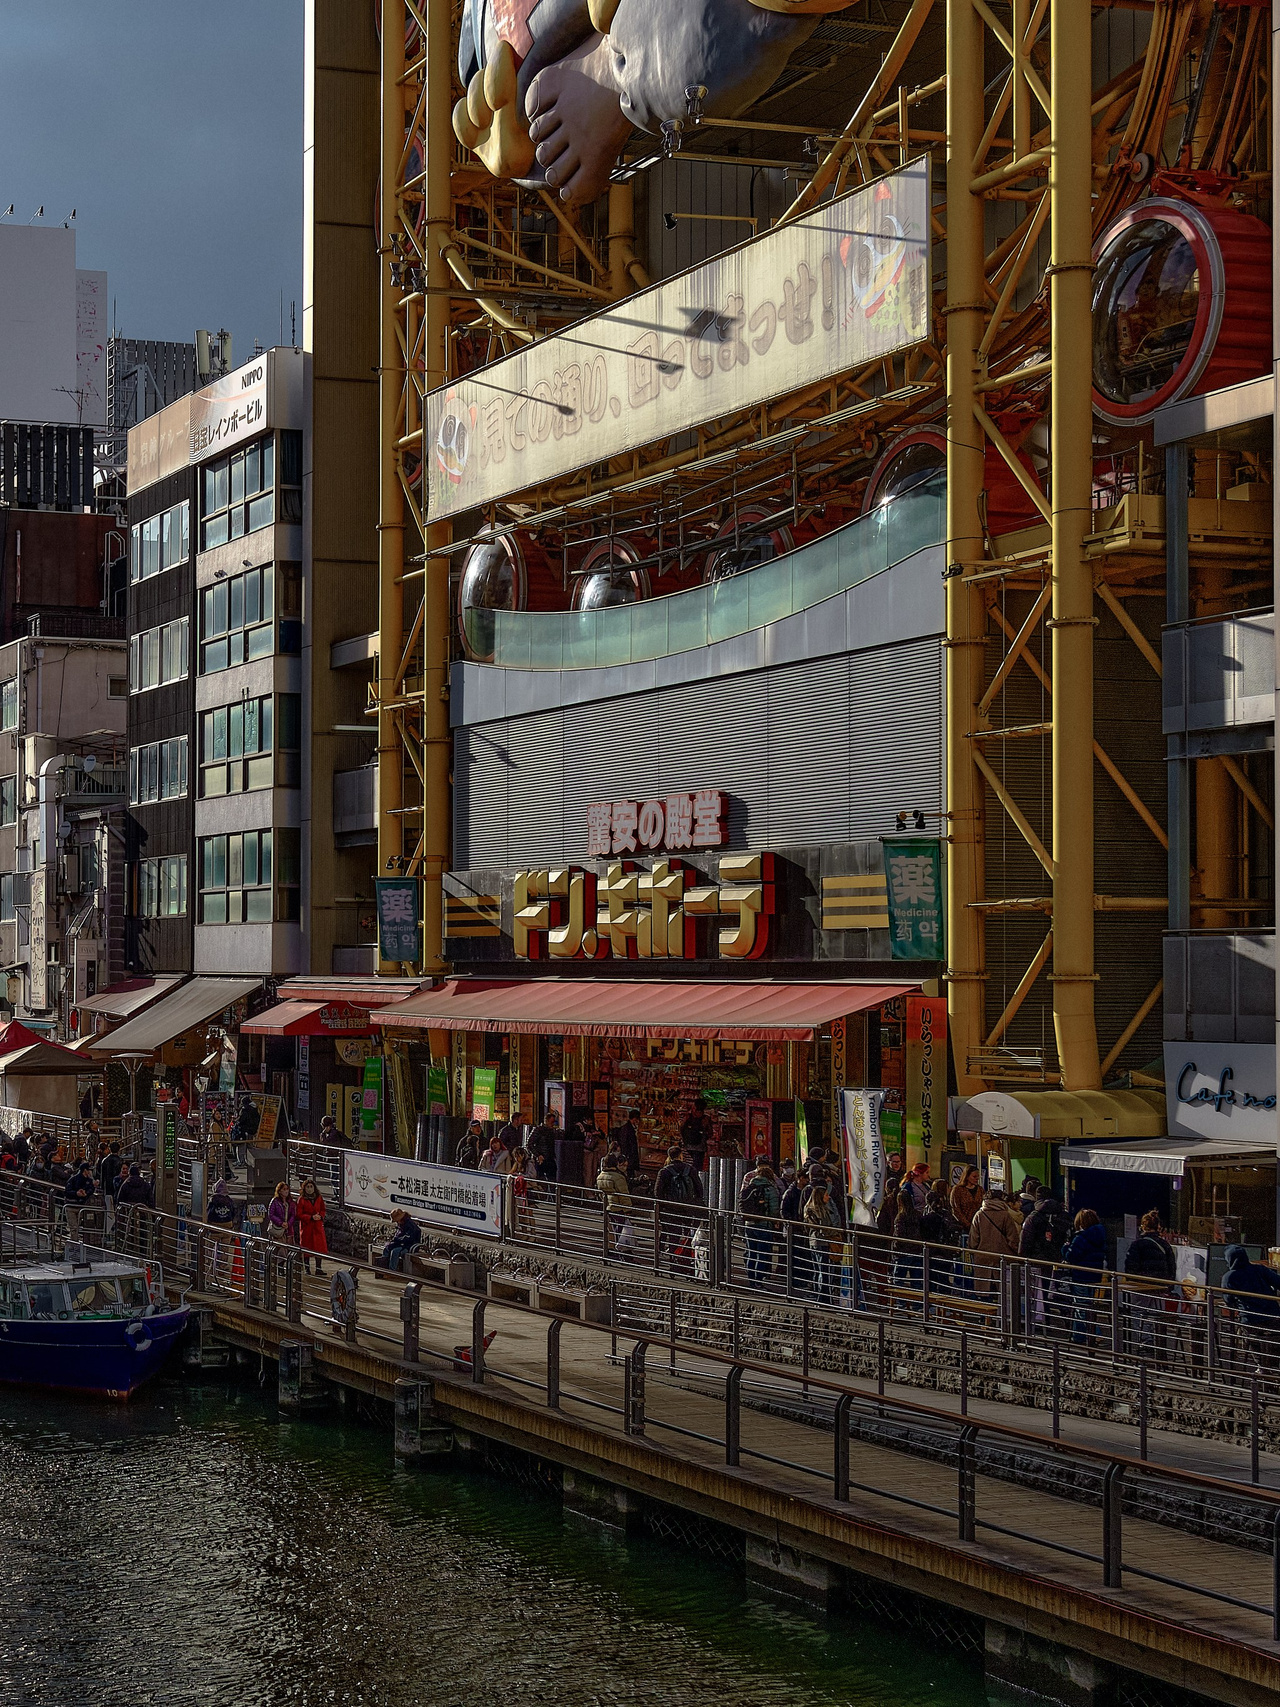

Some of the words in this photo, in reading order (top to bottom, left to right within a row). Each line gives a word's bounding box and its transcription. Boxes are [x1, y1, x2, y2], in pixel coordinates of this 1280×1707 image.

[241, 366, 263, 390] NIPPO
[586, 790, 723, 856] 驚安の殿堂
[889, 855, 936, 904] 薬
[380, 888, 414, 923] 薬
[893, 908, 939, 918] Medicine
[382, 924, 417, 932] Medicine
[894, 919, 913, 942] 药
[918, 920, 939, 943] 약
[401, 933, 417, 949] 약
